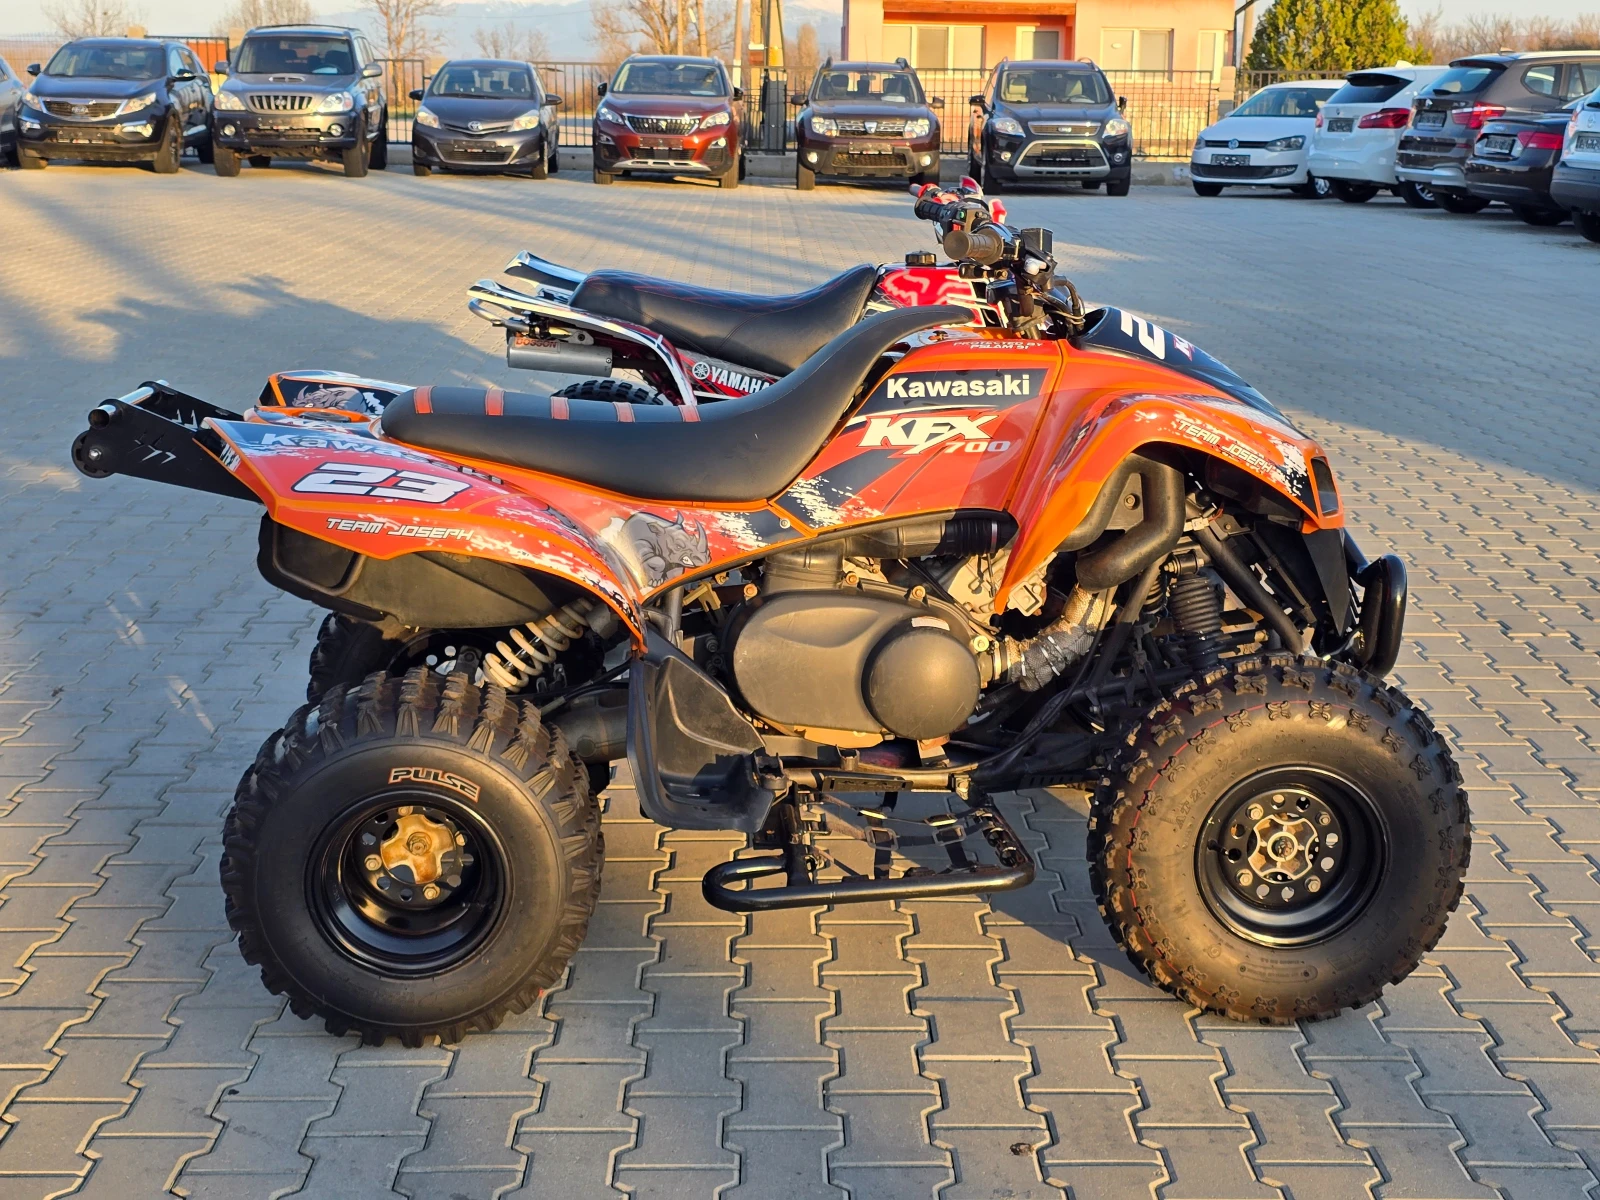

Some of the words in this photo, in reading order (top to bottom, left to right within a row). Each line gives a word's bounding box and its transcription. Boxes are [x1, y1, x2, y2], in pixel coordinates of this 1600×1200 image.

[886, 374, 1030, 399] Kawasaki
[857, 414, 1000, 455] KFX
[943, 441, 1011, 453] 700
[1177, 420, 1221, 446] TEAM
[1221, 443, 1274, 473] JOSEPH
[291, 462, 473, 504] 23
[326, 517, 385, 534] TEAM
[387, 525, 475, 541] JOSEPH
[388, 766, 481, 803] PULSE
